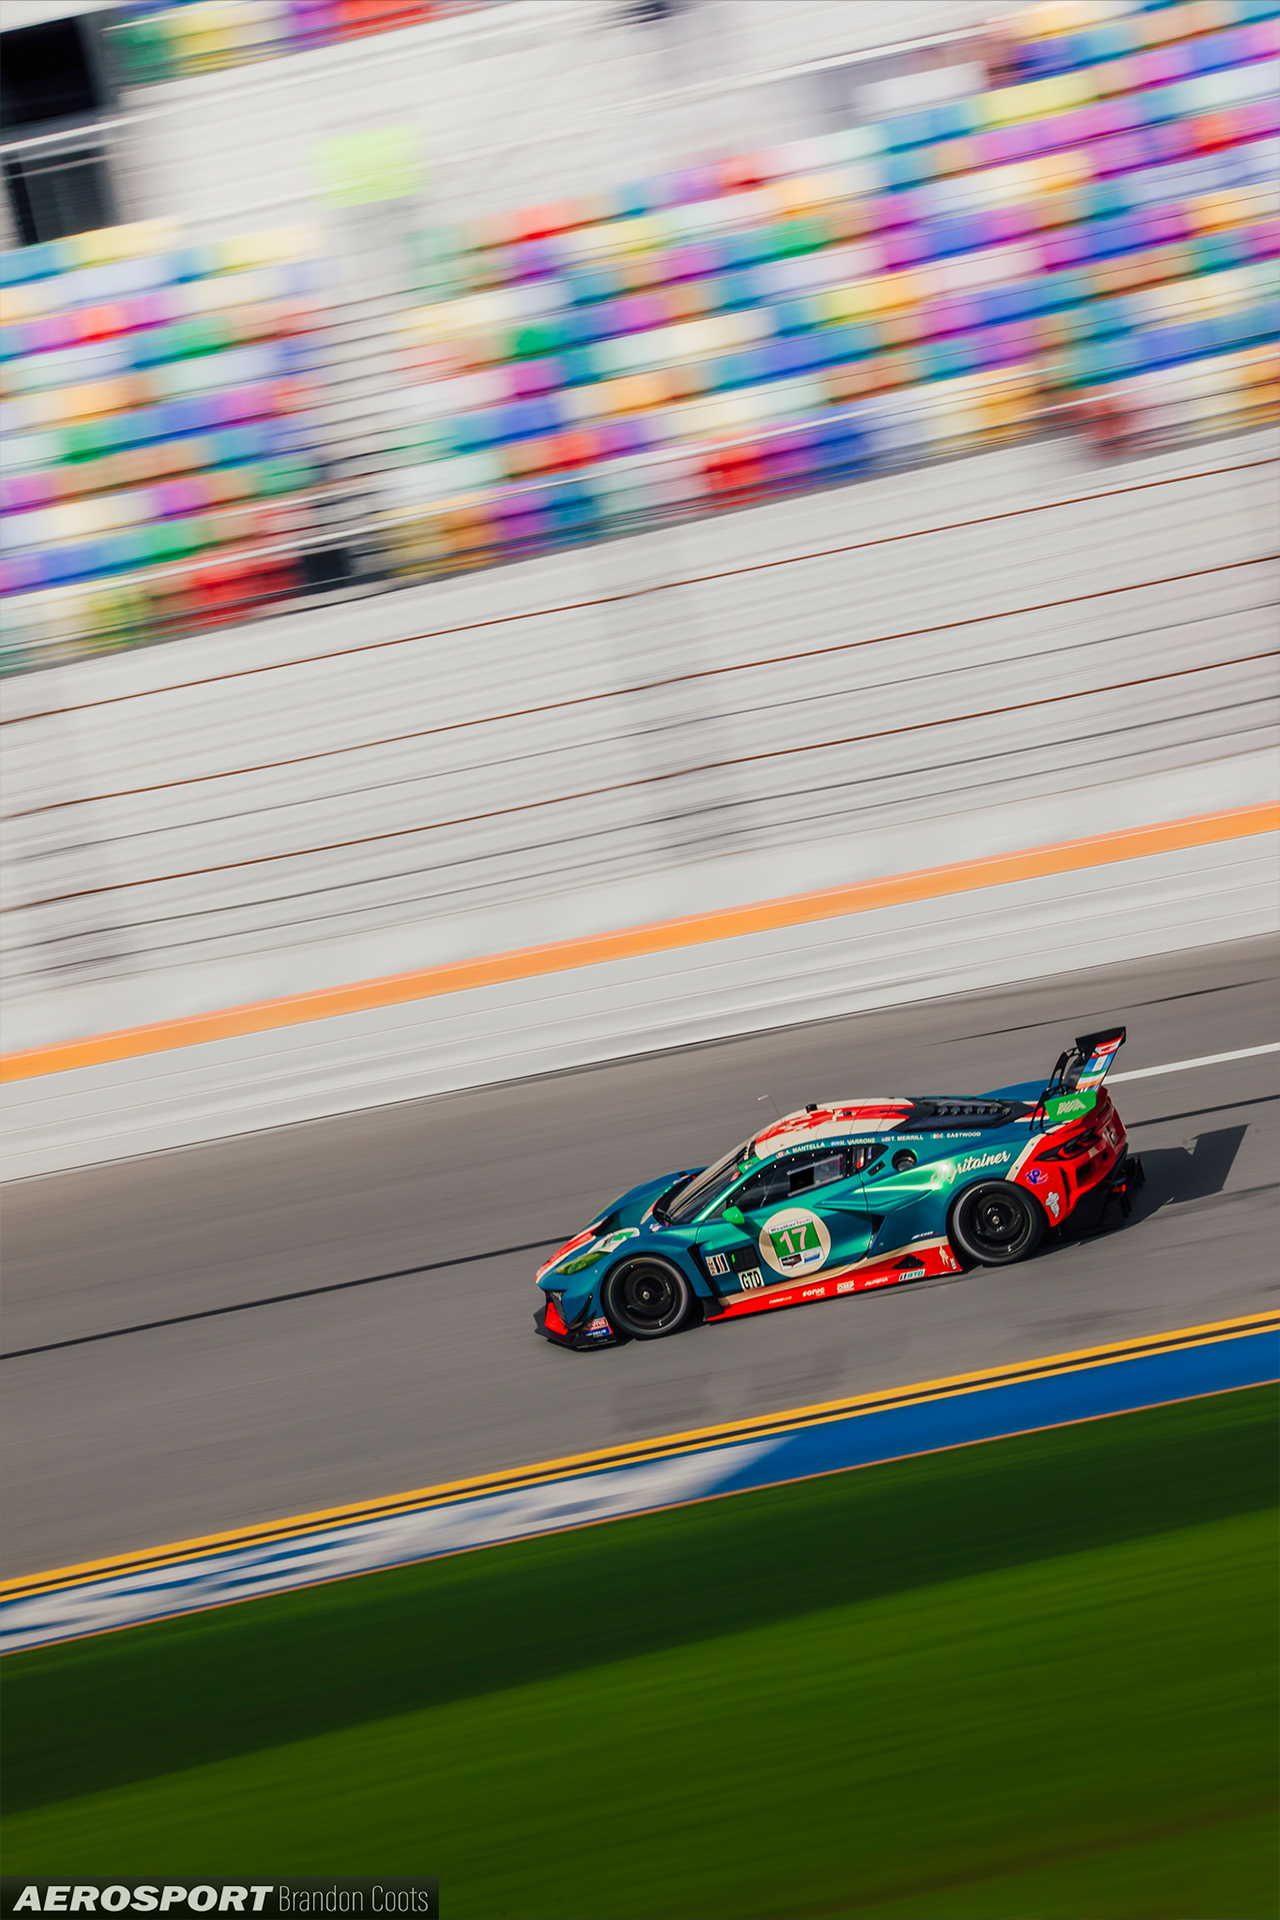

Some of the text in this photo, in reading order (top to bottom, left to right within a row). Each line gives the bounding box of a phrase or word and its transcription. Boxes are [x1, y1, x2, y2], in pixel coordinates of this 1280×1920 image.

[897, 1134, 924, 1142] MERRILL
[946, 1131, 982, 1139] EASTWOOD
[847, 1137, 876, 1146] VARRONE
[792, 1141, 826, 1153] MANTELLA
[779, 1226, 807, 1254] 17
[741, 1270, 762, 1290] GTD
